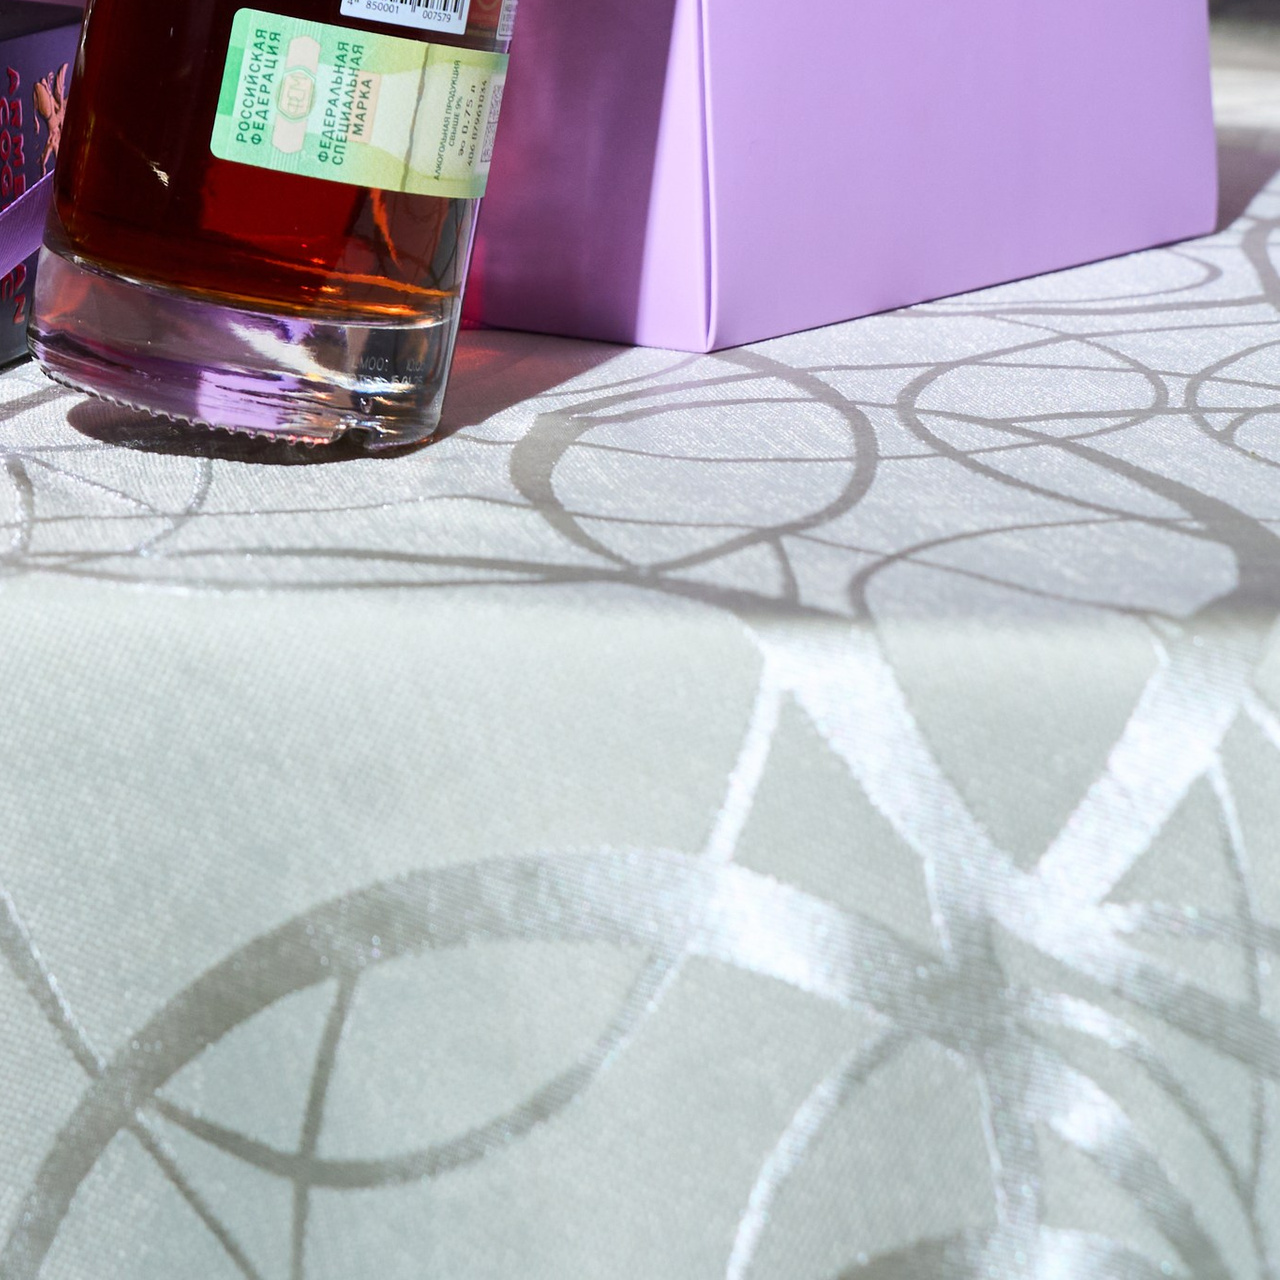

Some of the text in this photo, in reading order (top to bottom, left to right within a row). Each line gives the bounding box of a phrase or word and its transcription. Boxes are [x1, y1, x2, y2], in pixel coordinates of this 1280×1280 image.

[422, 11, 452, 23] 007579
[236, 28, 267, 143] РОССИЙСКАЯ
[251, 31, 281, 145] ФЕДЕРАЦИЯ
[318, 42, 350, 163] ФЕДЕРАЛЬНАЯ
[332, 44, 365, 166] СПЕЦИАЛЬНАЯ
[353, 78, 373, 137] МАРКА
[433, 59, 461, 181] АЛКОГОЛЬНАЯ ПРОДУКЦИЯ
[448, 95, 464, 147] СВЫШЕ 9%
[461, 99, 474, 135] 0.75
[466, 142, 476, 167] 406
